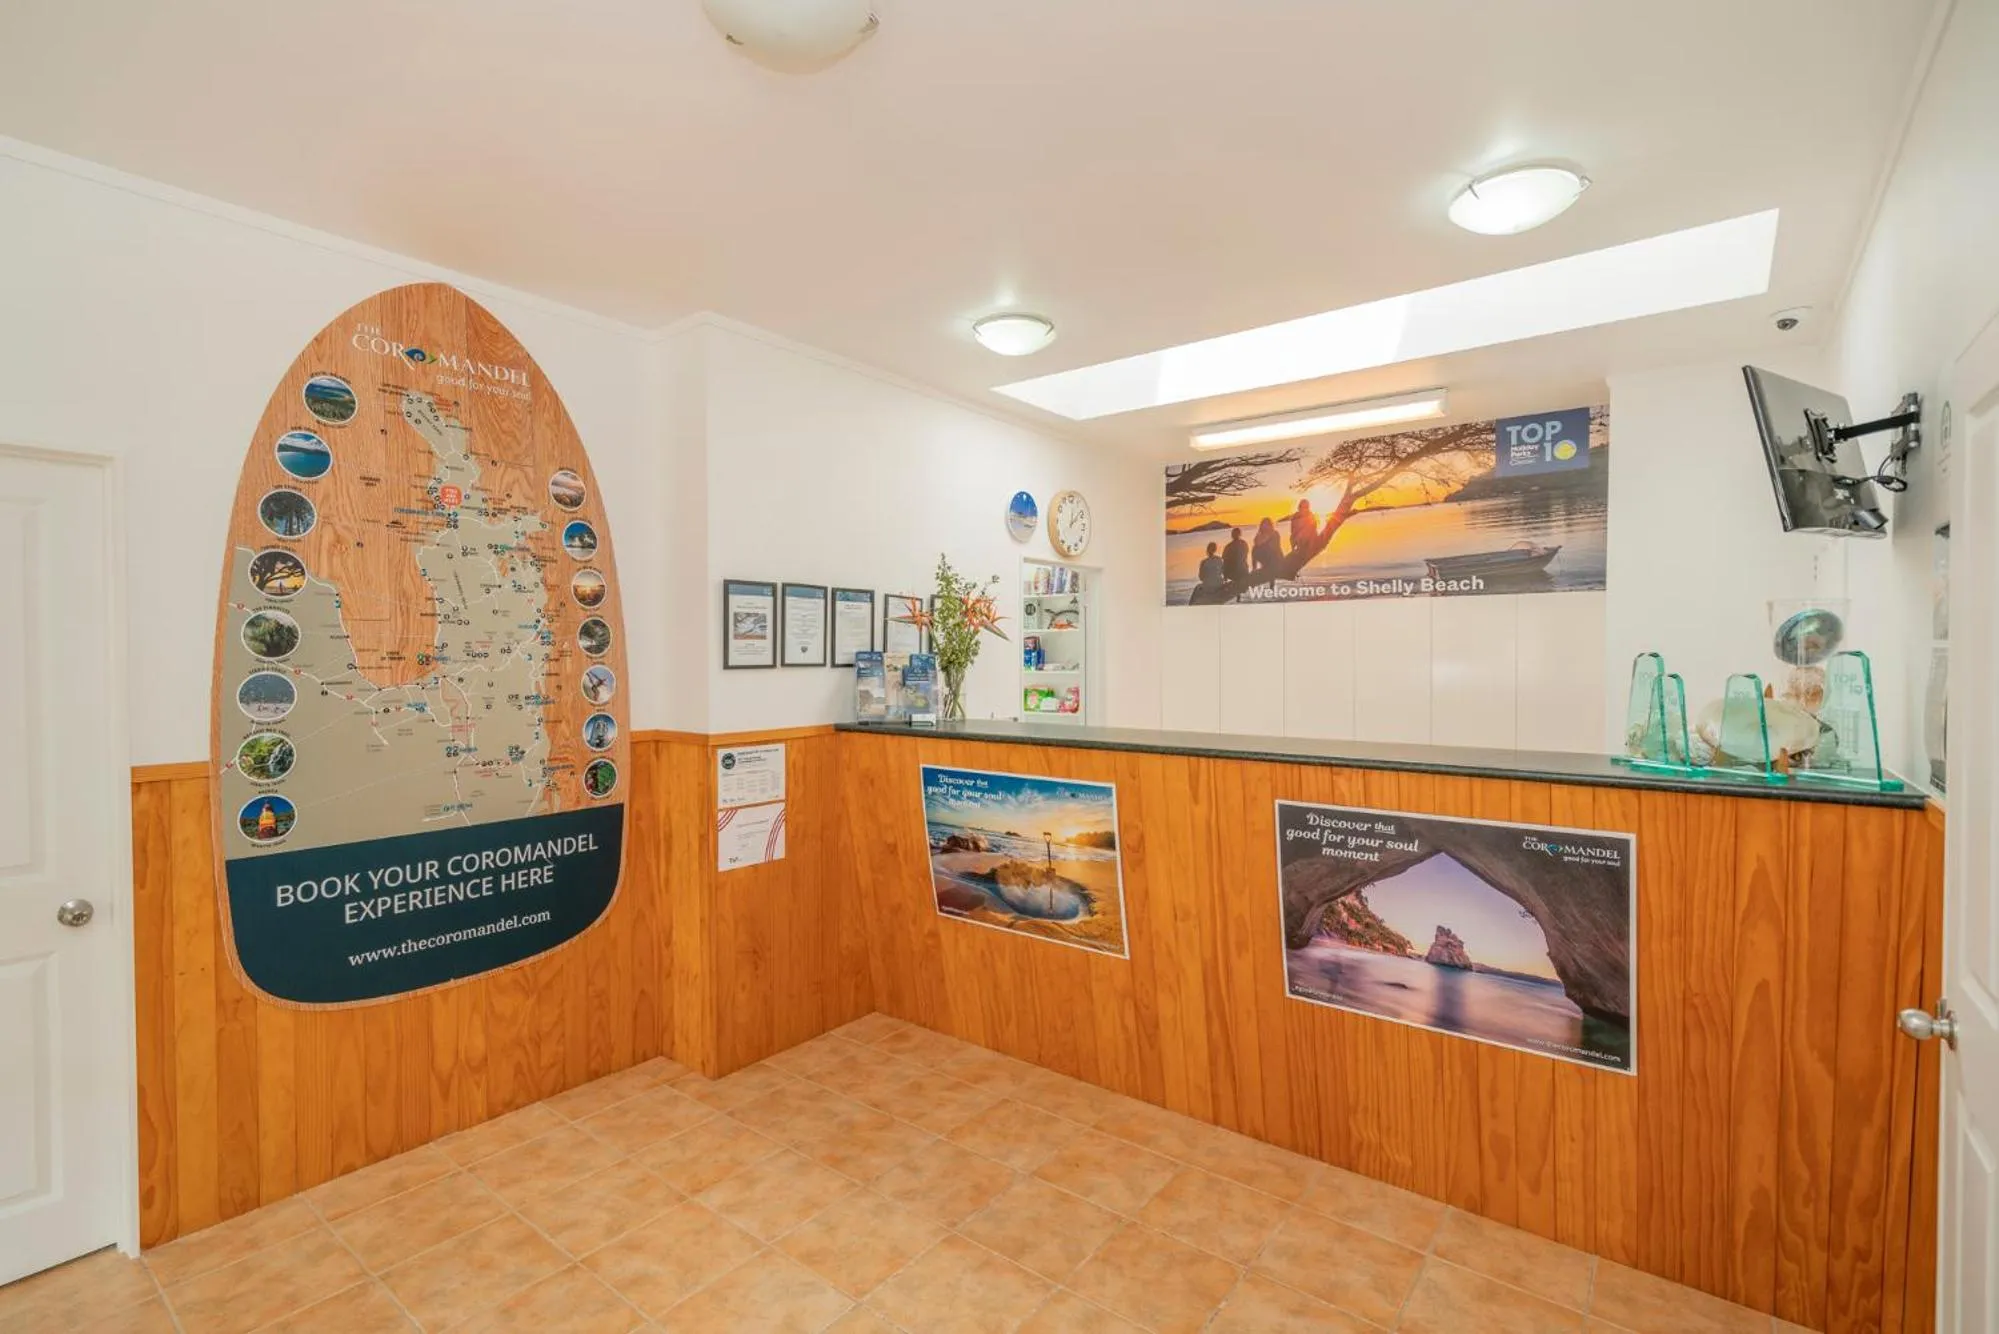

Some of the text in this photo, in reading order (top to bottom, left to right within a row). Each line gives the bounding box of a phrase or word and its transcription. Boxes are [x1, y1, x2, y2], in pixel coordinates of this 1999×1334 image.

[436, 374, 466, 386] good
[467, 379, 484, 392] for
[487, 385, 510, 397] your
[1506, 420, 1563, 446] TOP
[1248, 575, 1485, 599] Welcome to Shelly Beach
[938, 773, 975, 786] Discover
[1306, 812, 1395, 833] Discover that
[1286, 828, 1420, 853] good for your soul
[1321, 846, 1380, 862] moment
[276, 833, 599, 908] BOOK YOUR COROMANDEL
[344, 865, 555, 925] EXPERIENCE HERE
[348, 910, 551, 967] www.thecoromandel.com
